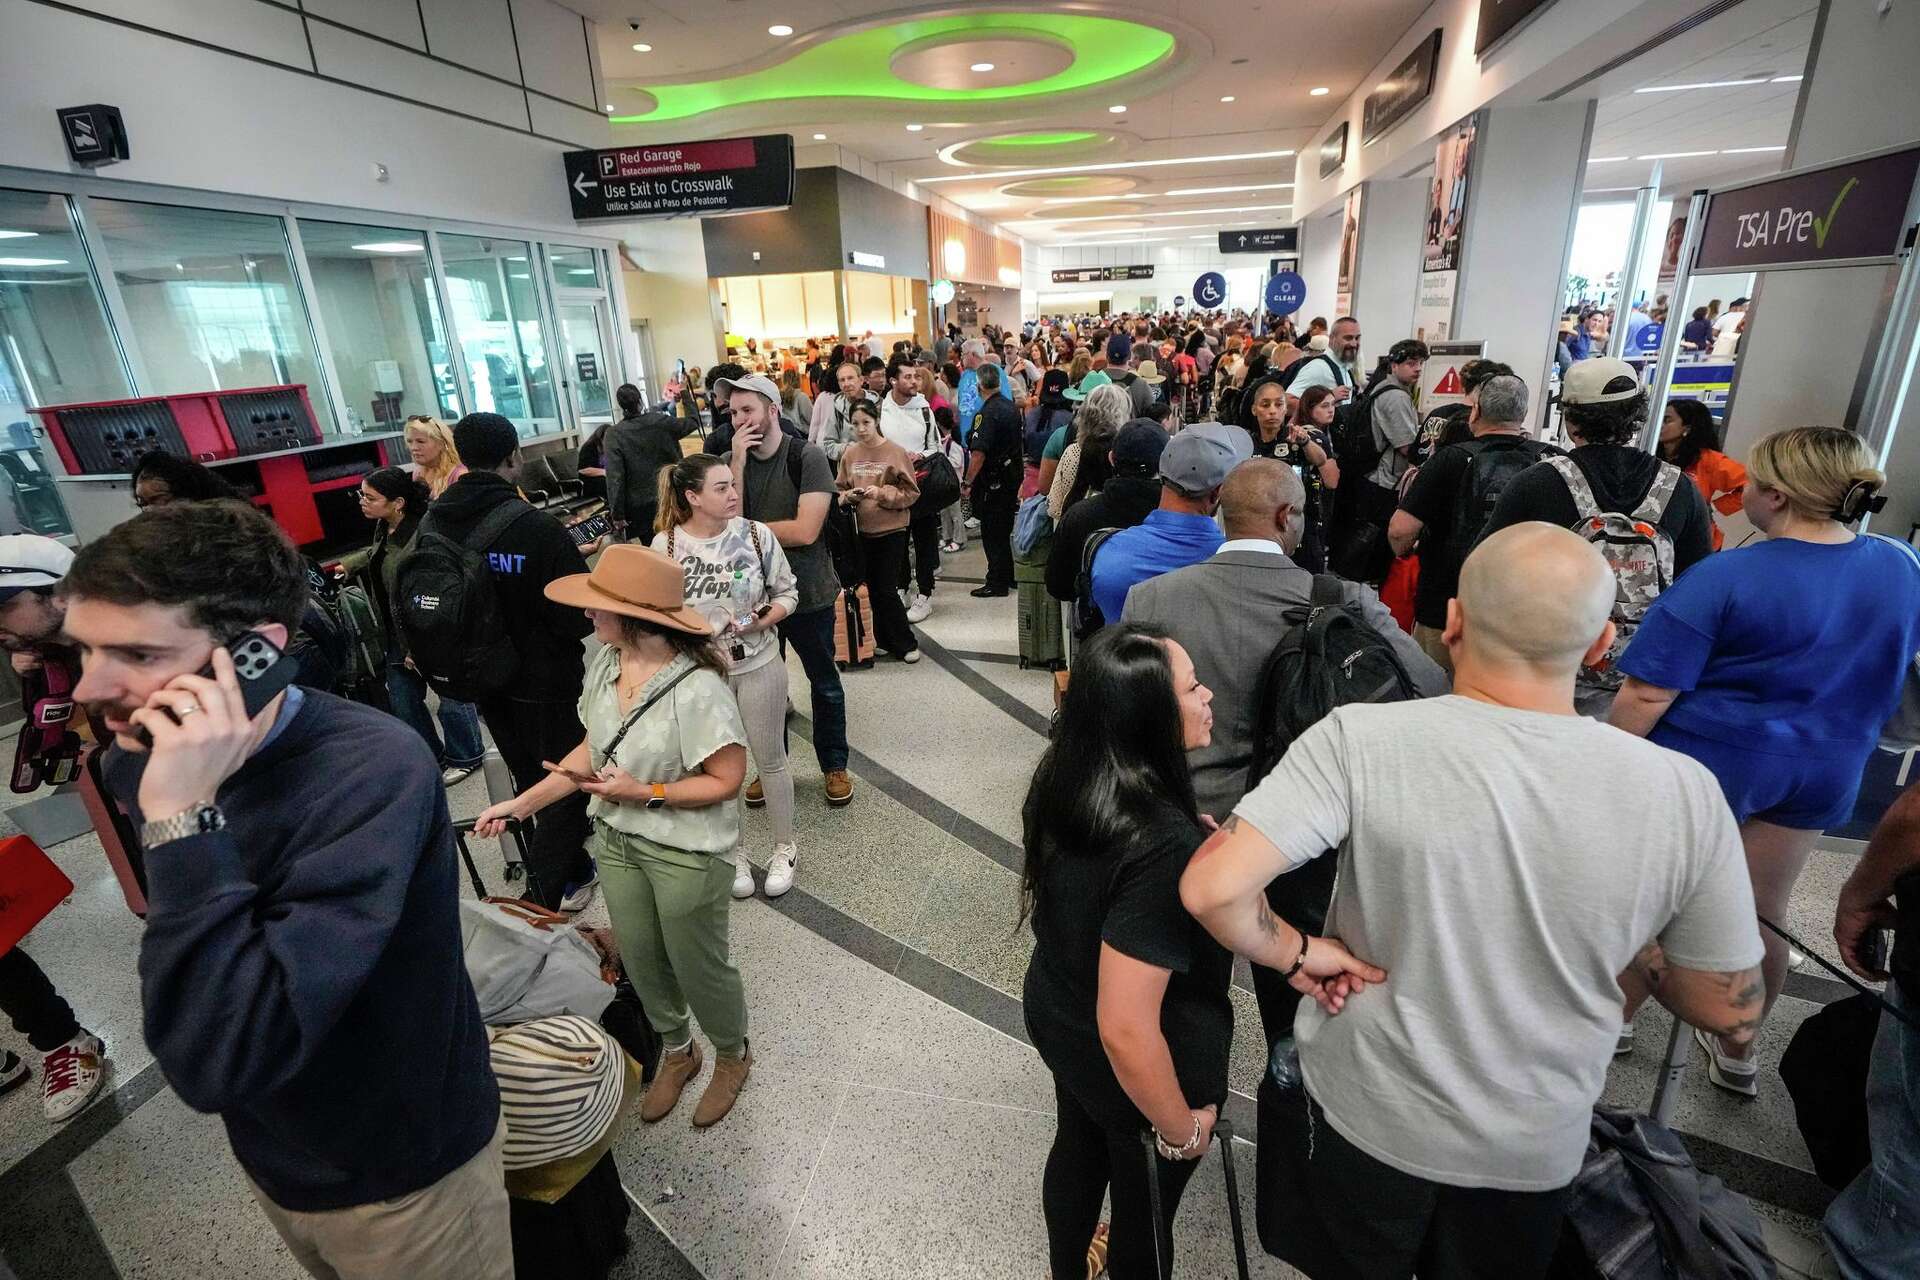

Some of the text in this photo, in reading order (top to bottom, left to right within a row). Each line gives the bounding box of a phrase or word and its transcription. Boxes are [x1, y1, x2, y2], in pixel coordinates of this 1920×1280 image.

[603, 157, 614, 175] P
[620, 150, 683, 165] Red Garage
[621, 162, 702, 177] Estacionamiento Rojo
[604, 175, 734, 199] Use Exit to Crosswalk
[606, 196, 728, 212] Utilice Salida al Paso de Peatones
[1735, 207, 1813, 249] TSA Pre
[1273, 294, 1297, 302] CLEAR
[680, 555, 751, 576] Choose
[684, 575, 732, 600] Hap
